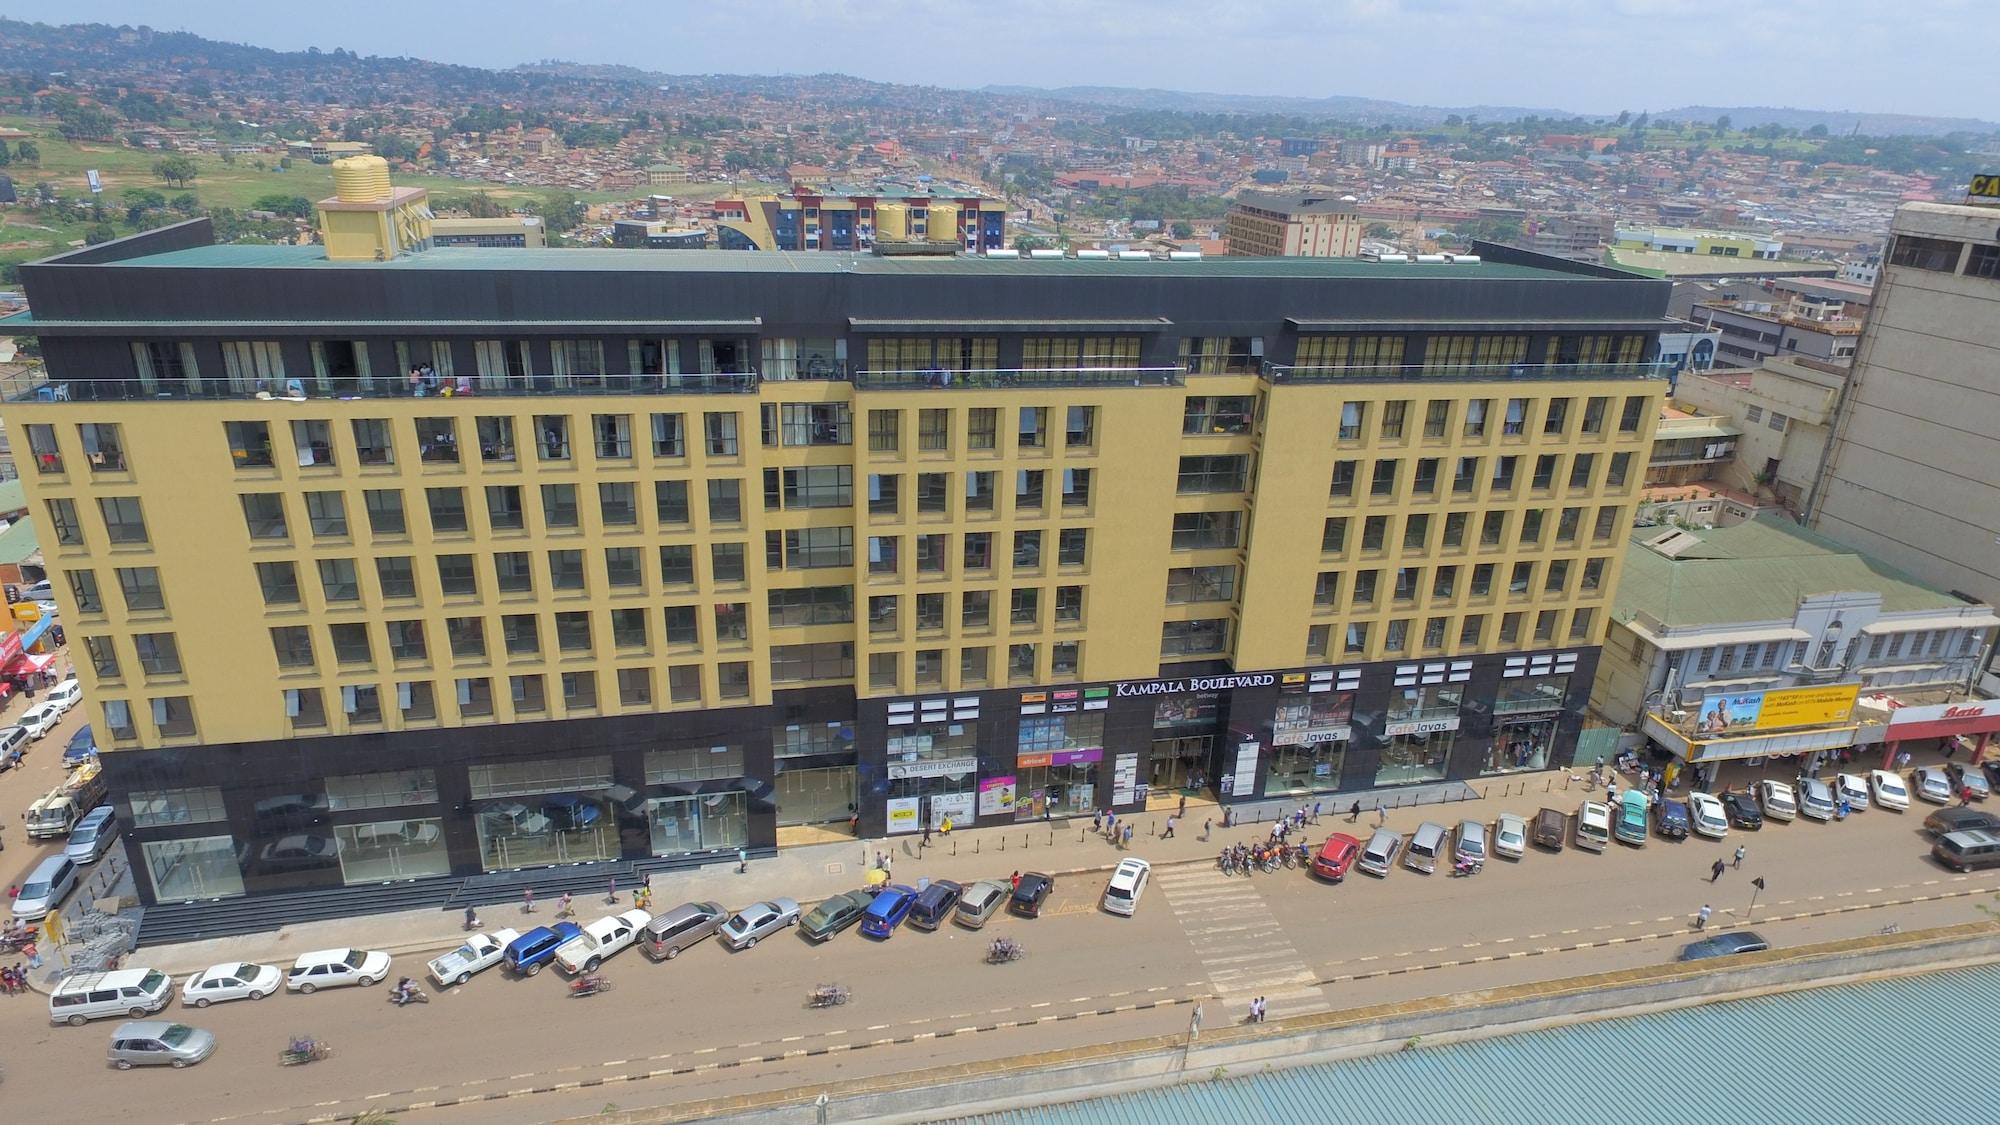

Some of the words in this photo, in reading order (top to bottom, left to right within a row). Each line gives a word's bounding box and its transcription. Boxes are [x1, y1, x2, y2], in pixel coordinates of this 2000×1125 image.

[1116, 682, 1185, 697] KAMPALA
[1189, 674, 1275, 691] BOULEVARD
[1940, 705, 1985, 718] Bata
[909, 764, 937, 772] DESERT
[938, 760, 975, 769] EXCHANGE
